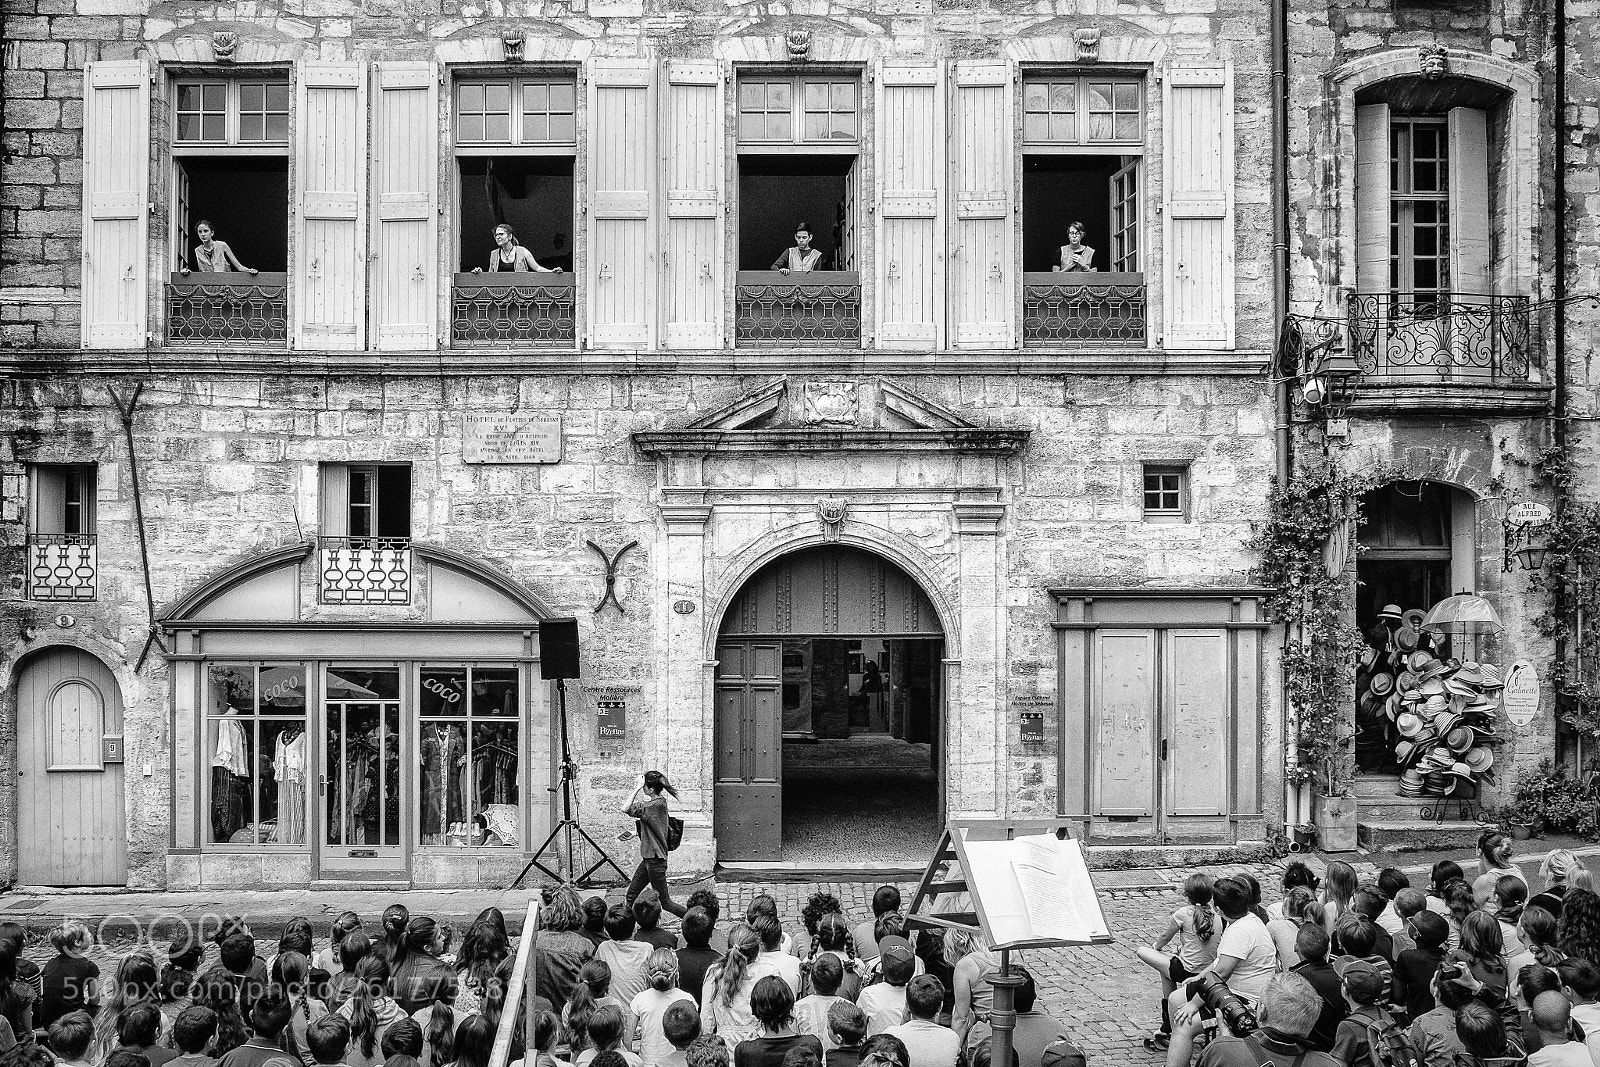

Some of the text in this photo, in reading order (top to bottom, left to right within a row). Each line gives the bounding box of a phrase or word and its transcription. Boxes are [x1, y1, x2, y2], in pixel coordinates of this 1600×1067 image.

[423, 678, 461, 703] COCO
[606, 685, 642, 693] Ressources
[109, 744, 115, 752] 9
